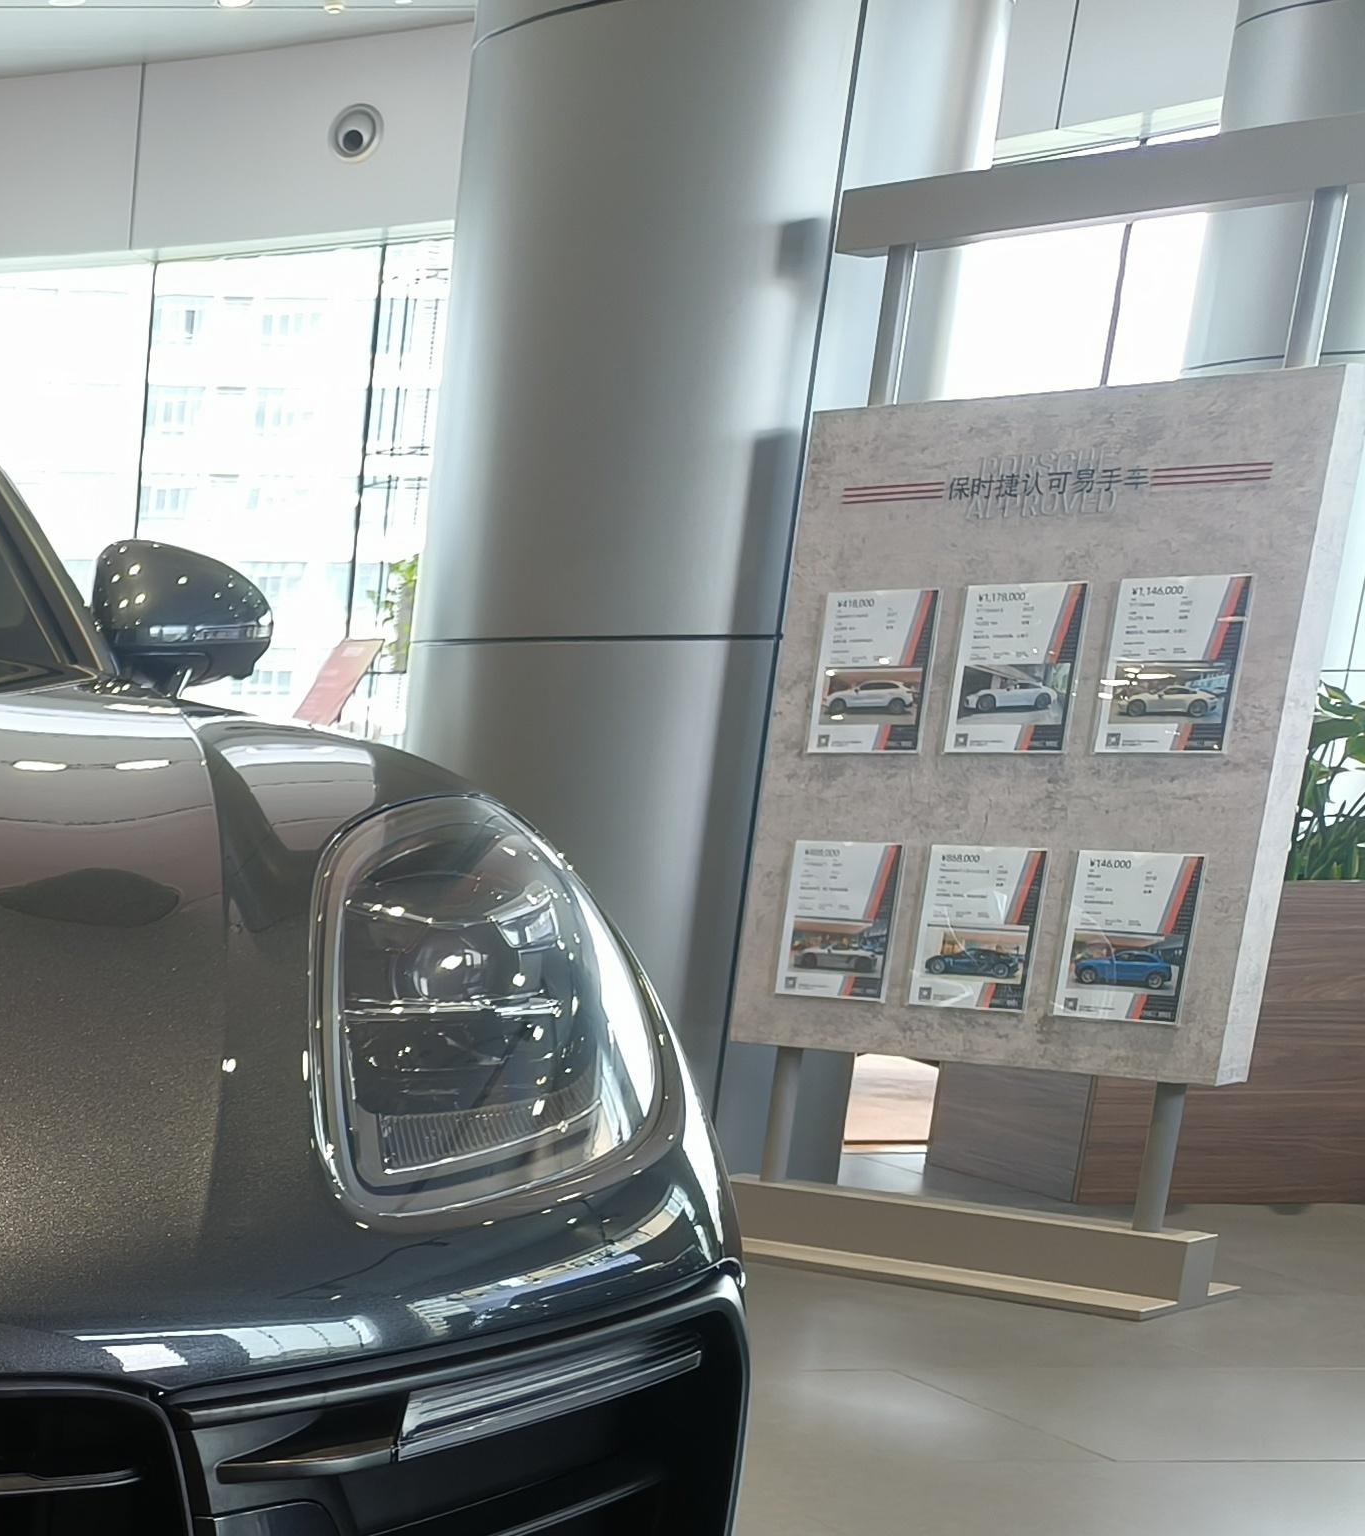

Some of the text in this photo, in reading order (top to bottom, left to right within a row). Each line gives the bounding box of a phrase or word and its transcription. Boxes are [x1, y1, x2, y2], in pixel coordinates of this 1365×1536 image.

[979, 447, 1118, 478] PORSCHE
[949, 466, 1149, 501] 保时捷认可易手车
